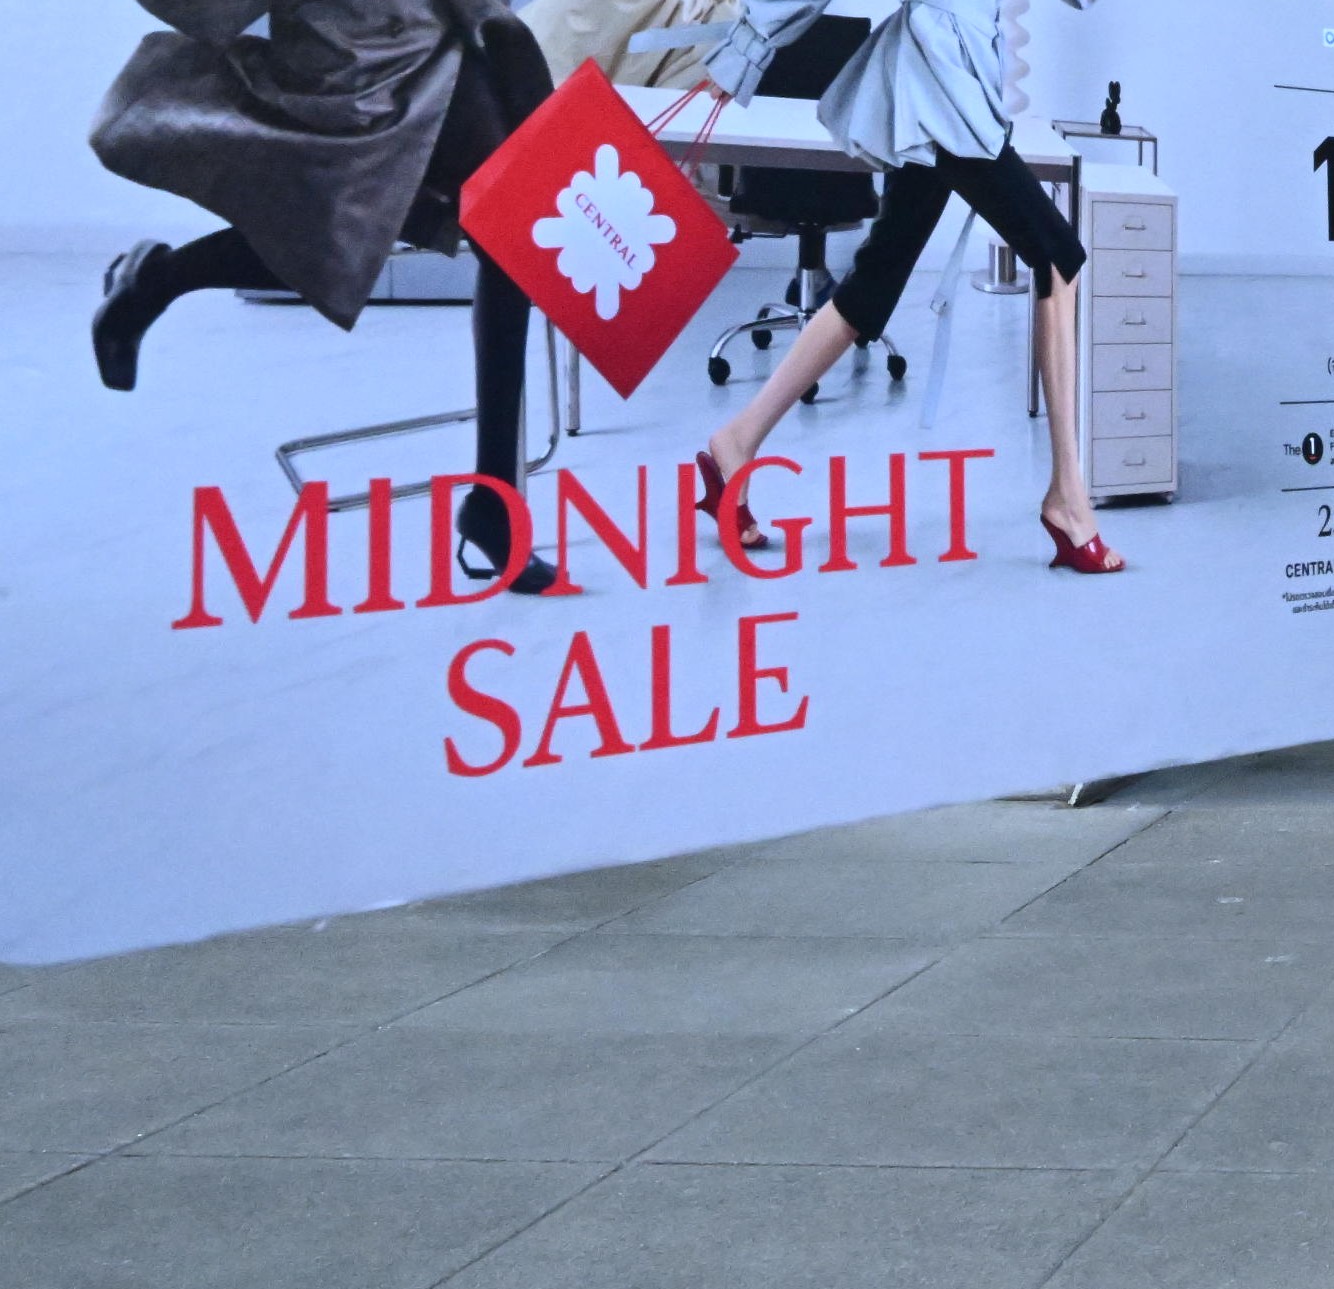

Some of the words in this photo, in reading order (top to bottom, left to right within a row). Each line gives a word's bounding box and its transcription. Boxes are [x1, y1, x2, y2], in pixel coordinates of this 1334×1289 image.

[574, 192, 639, 270] CENTRAL
[1283, 442, 1302, 456] The
[170, 447, 996, 632] MIDNIGHT
[443, 610, 810, 778] SALE
